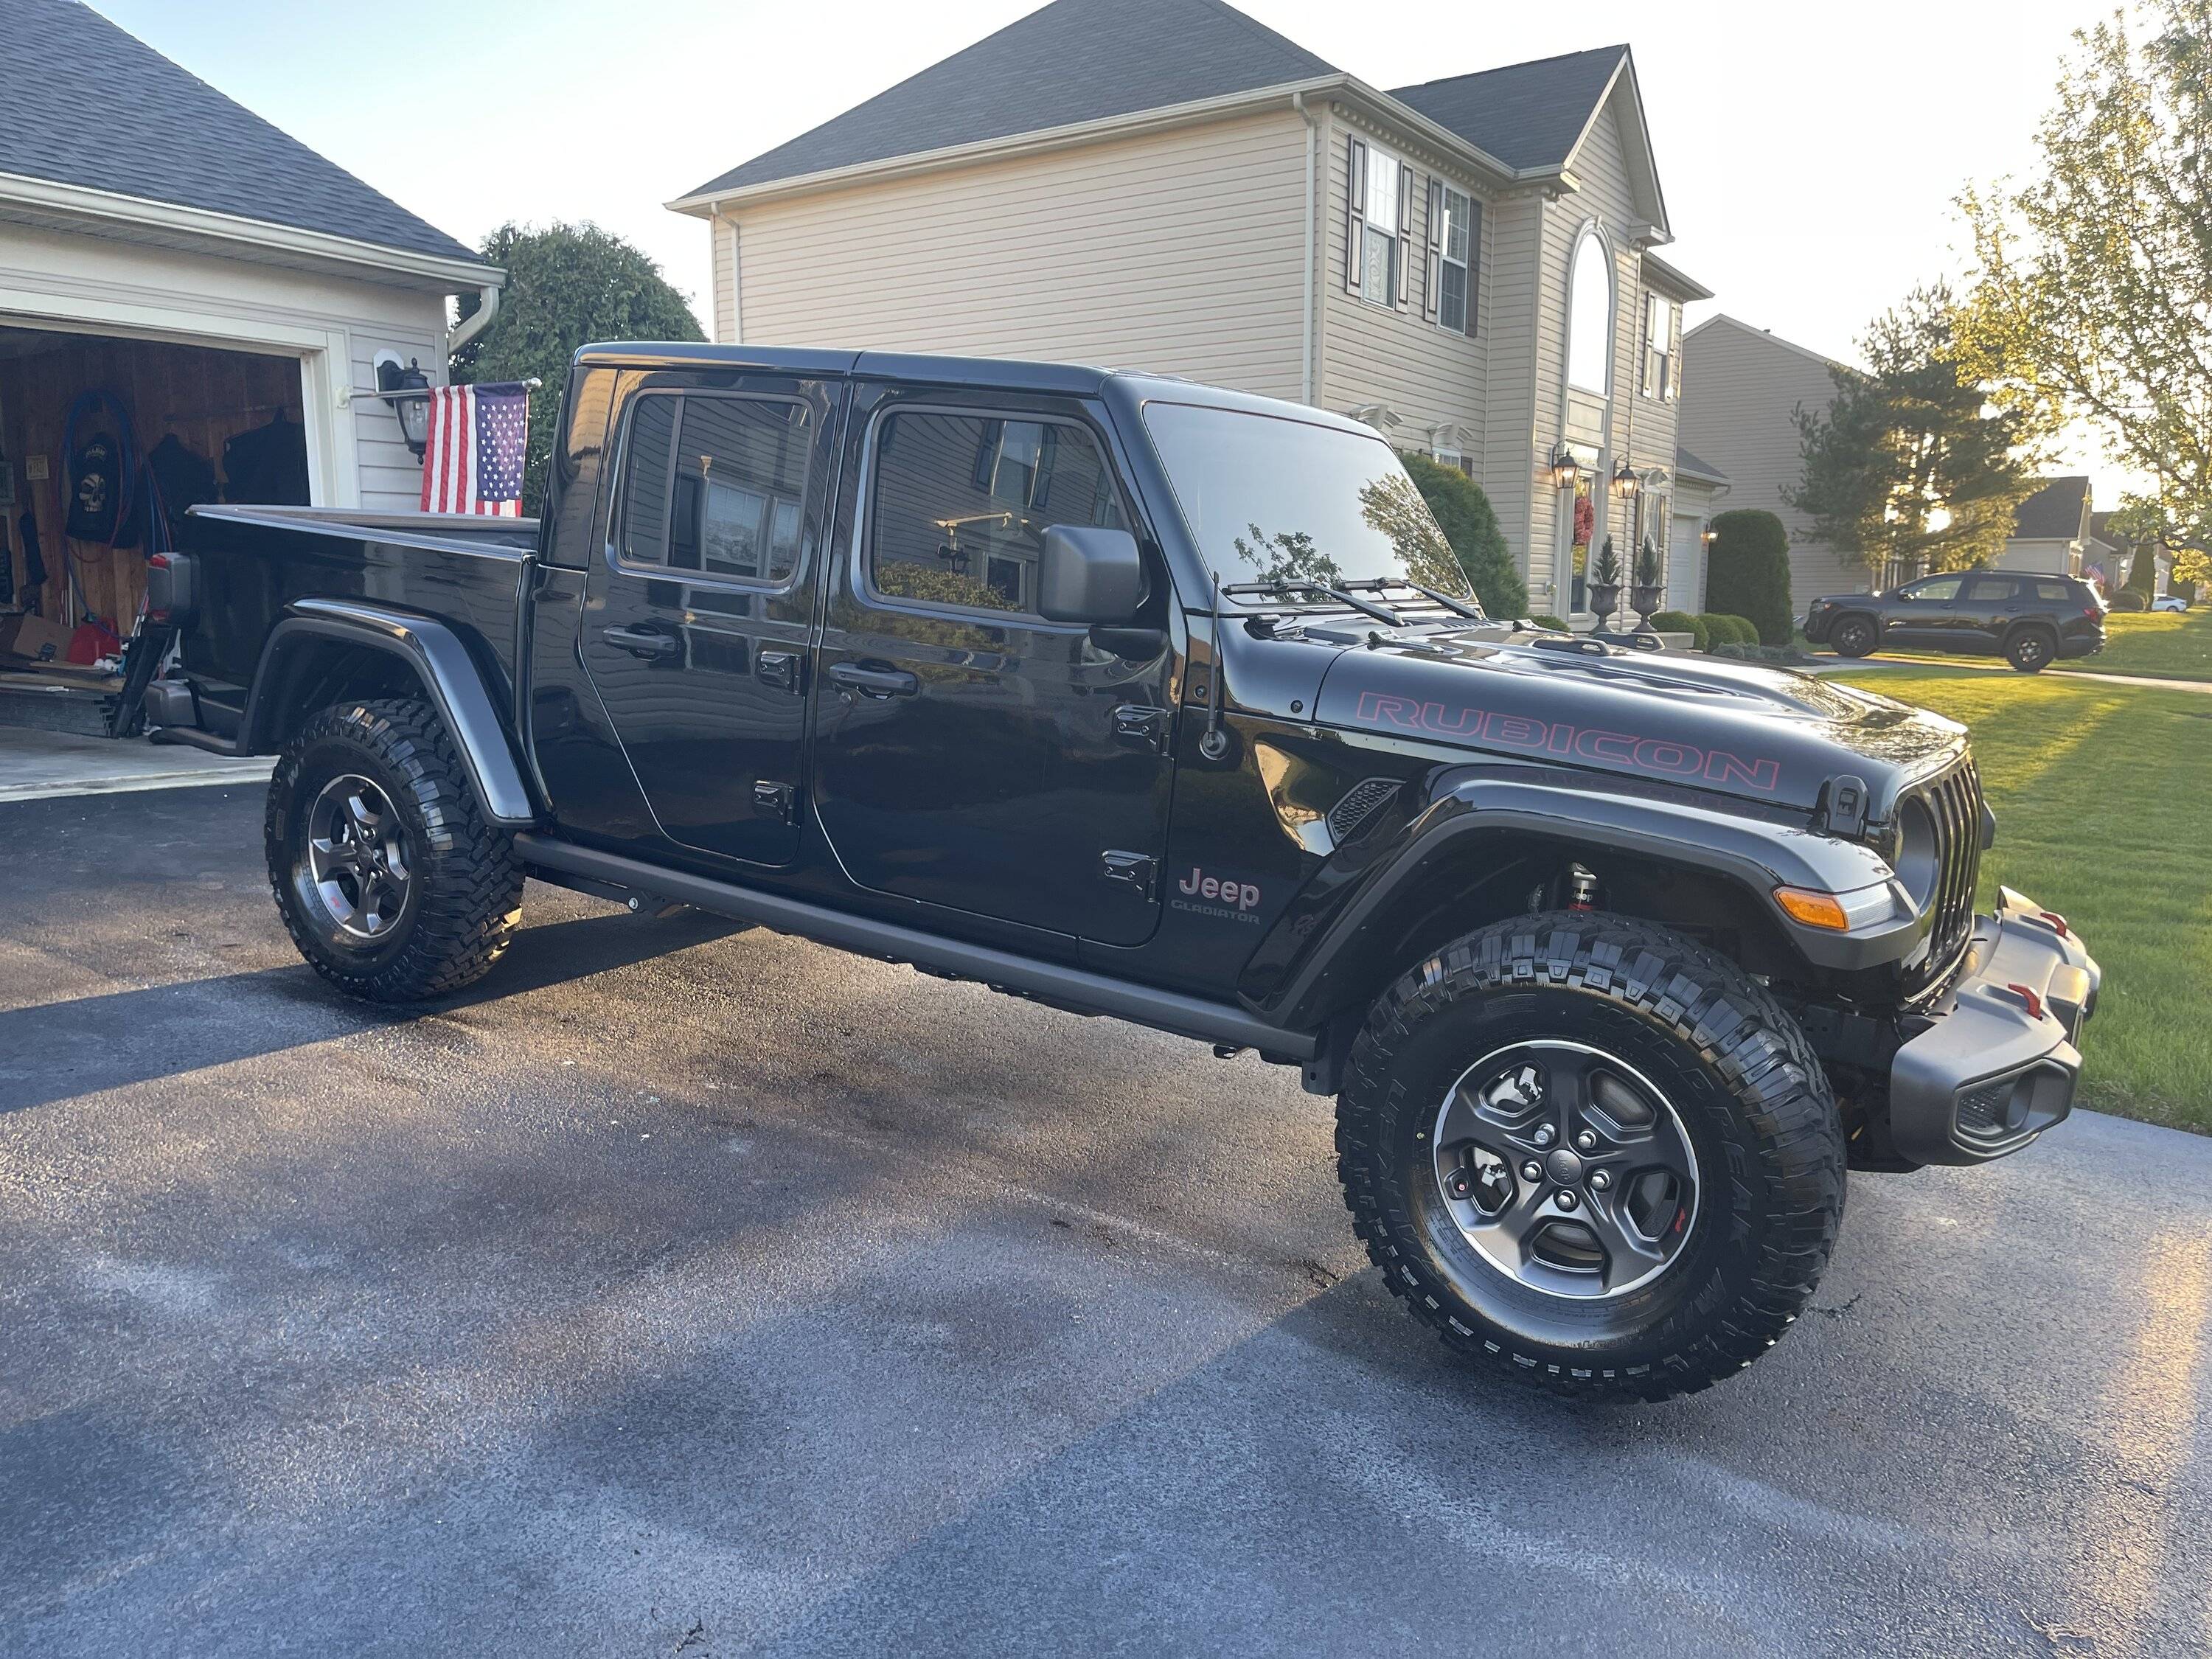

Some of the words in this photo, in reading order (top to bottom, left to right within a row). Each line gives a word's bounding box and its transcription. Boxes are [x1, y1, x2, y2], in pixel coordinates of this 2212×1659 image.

[1356, 690, 1781, 791] RUBICON
[1179, 867, 1259, 911] Jeep
[1571, 890, 1593, 902] Jeep
[1170, 899, 1261, 925] GLADIATOR
